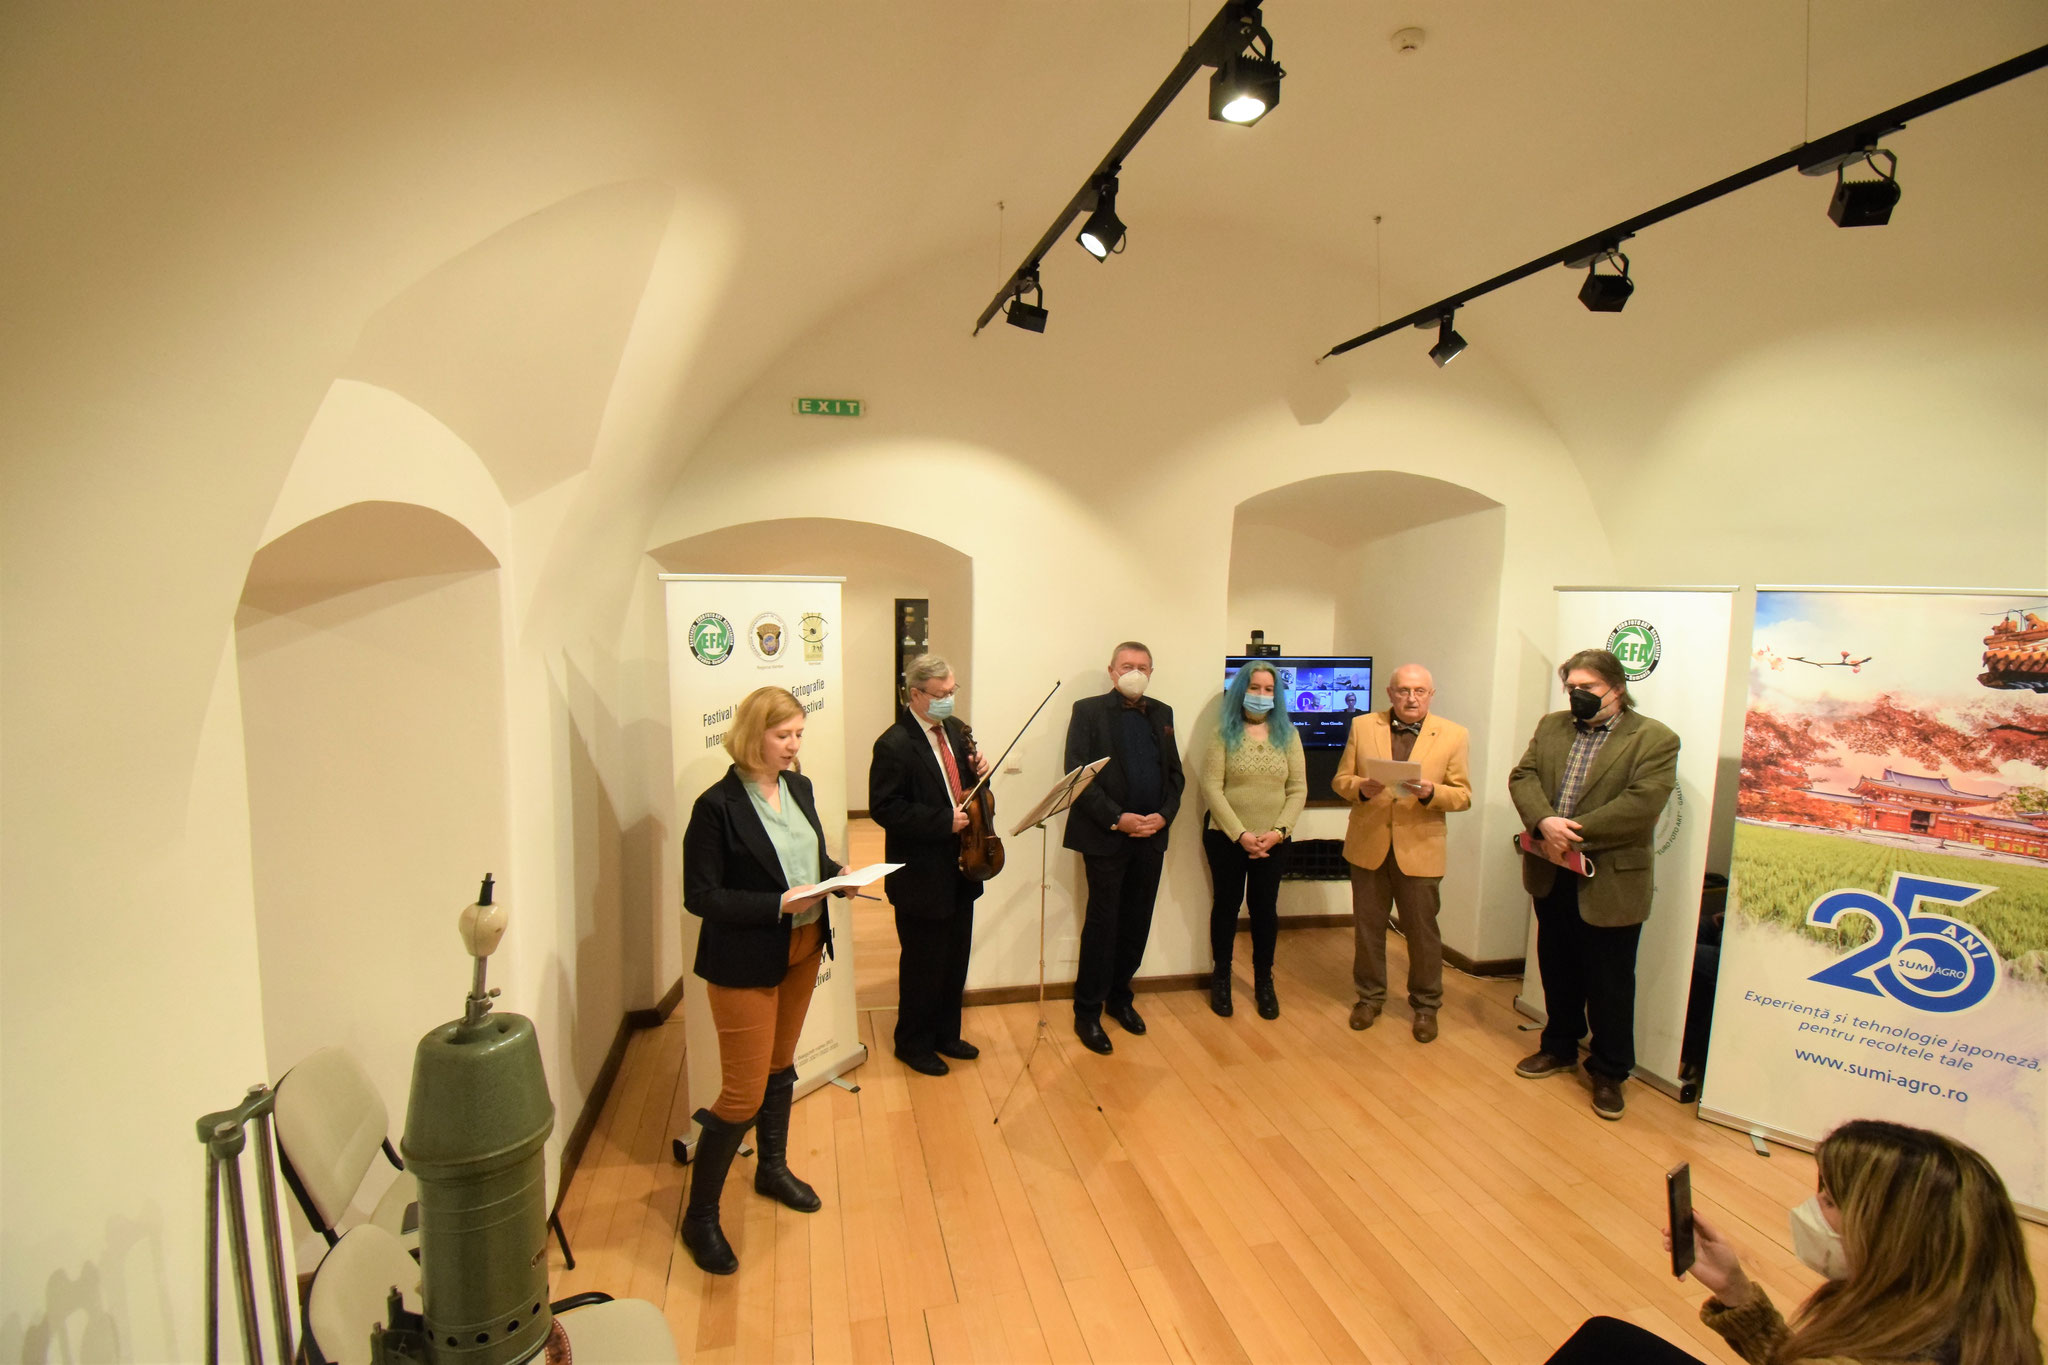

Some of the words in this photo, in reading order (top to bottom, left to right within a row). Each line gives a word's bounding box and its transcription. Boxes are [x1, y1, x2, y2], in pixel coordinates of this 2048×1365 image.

[801, 400, 857, 414] EXIT
[791, 679, 824, 698] Fotografie
[703, 704, 732, 727] Festival
[803, 698, 824, 715] estival
[1806, 874, 1997, 1013] 25
[1941, 924, 1989, 959] ANI
[1798, 1021, 1855, 1042] pentru
[1859, 1036, 1934, 1062] recoltele
[1939, 1054, 1974, 1071] tale
[1852, 1017, 1948, 1048] tehnologie
[1795, 1048, 1969, 1103] www.sumi-agro.ro
